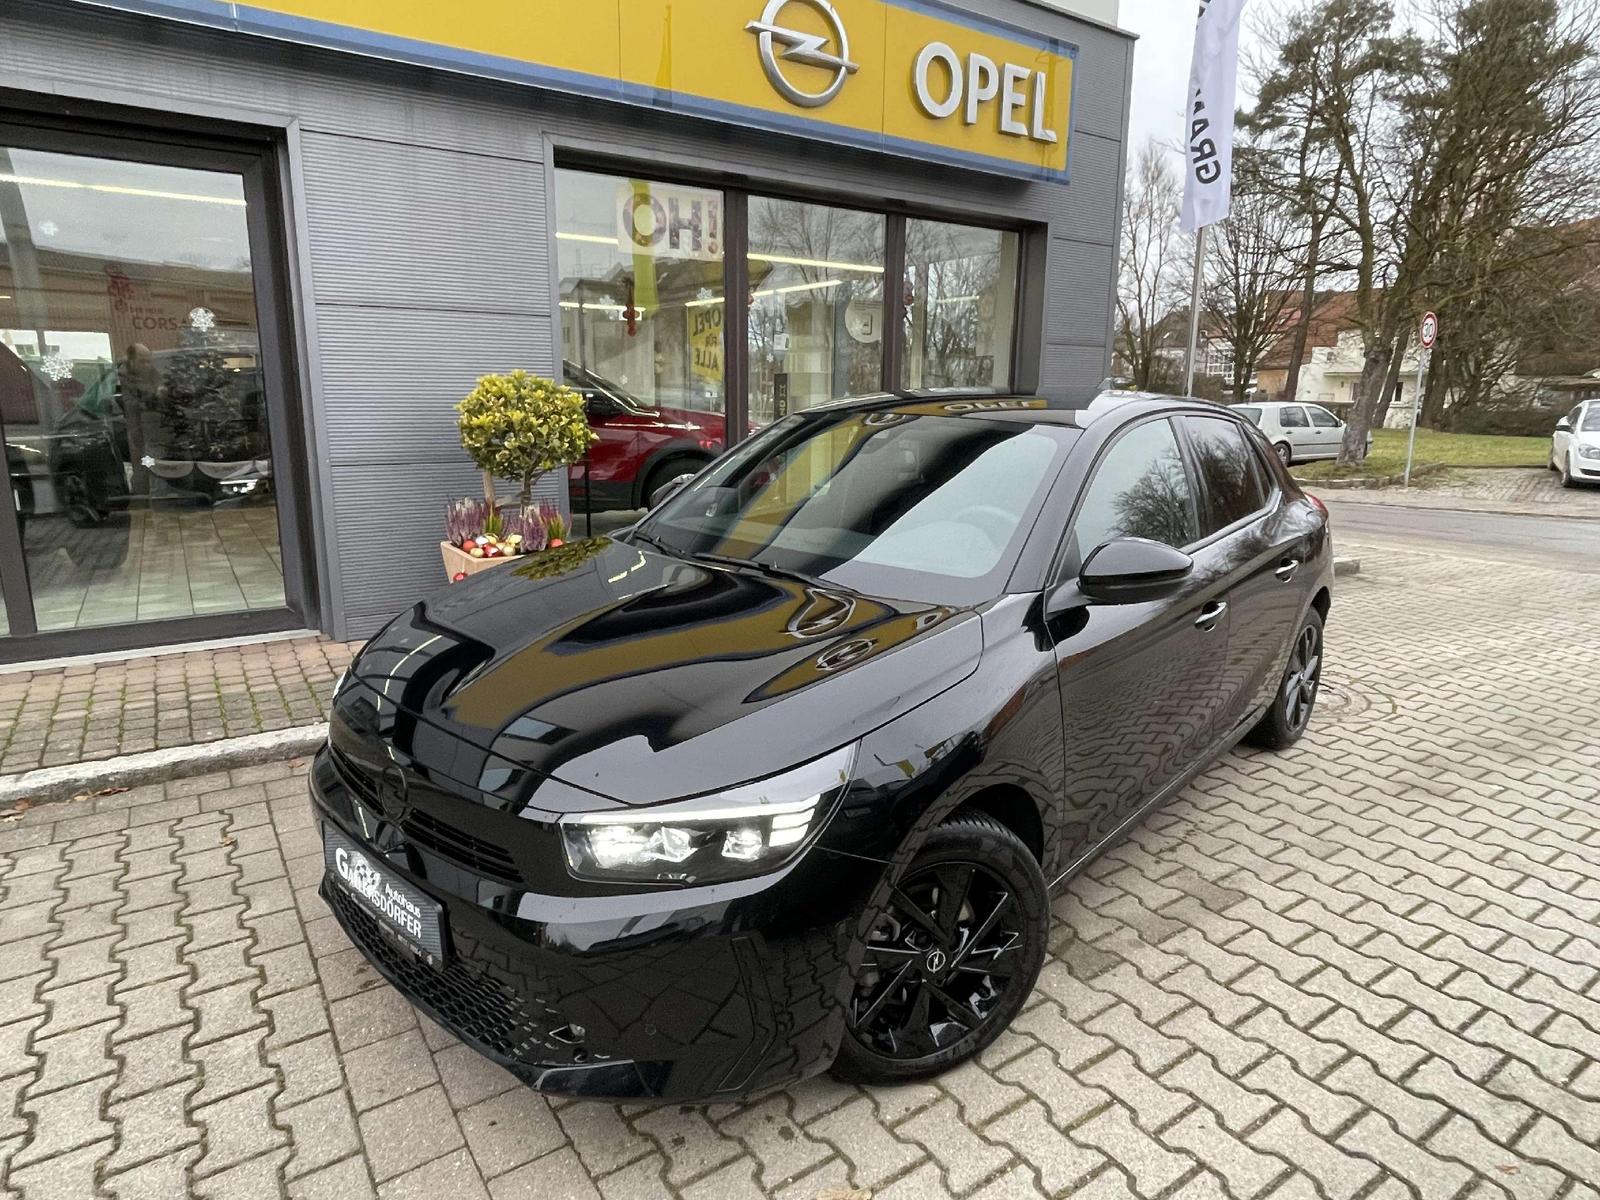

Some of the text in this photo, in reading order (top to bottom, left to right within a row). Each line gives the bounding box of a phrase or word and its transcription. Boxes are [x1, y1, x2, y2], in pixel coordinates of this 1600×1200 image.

[914, 42, 1057, 144] OPEL
[623, 193, 718, 254] OH!
[385, 882, 421, 919] Autohaus
